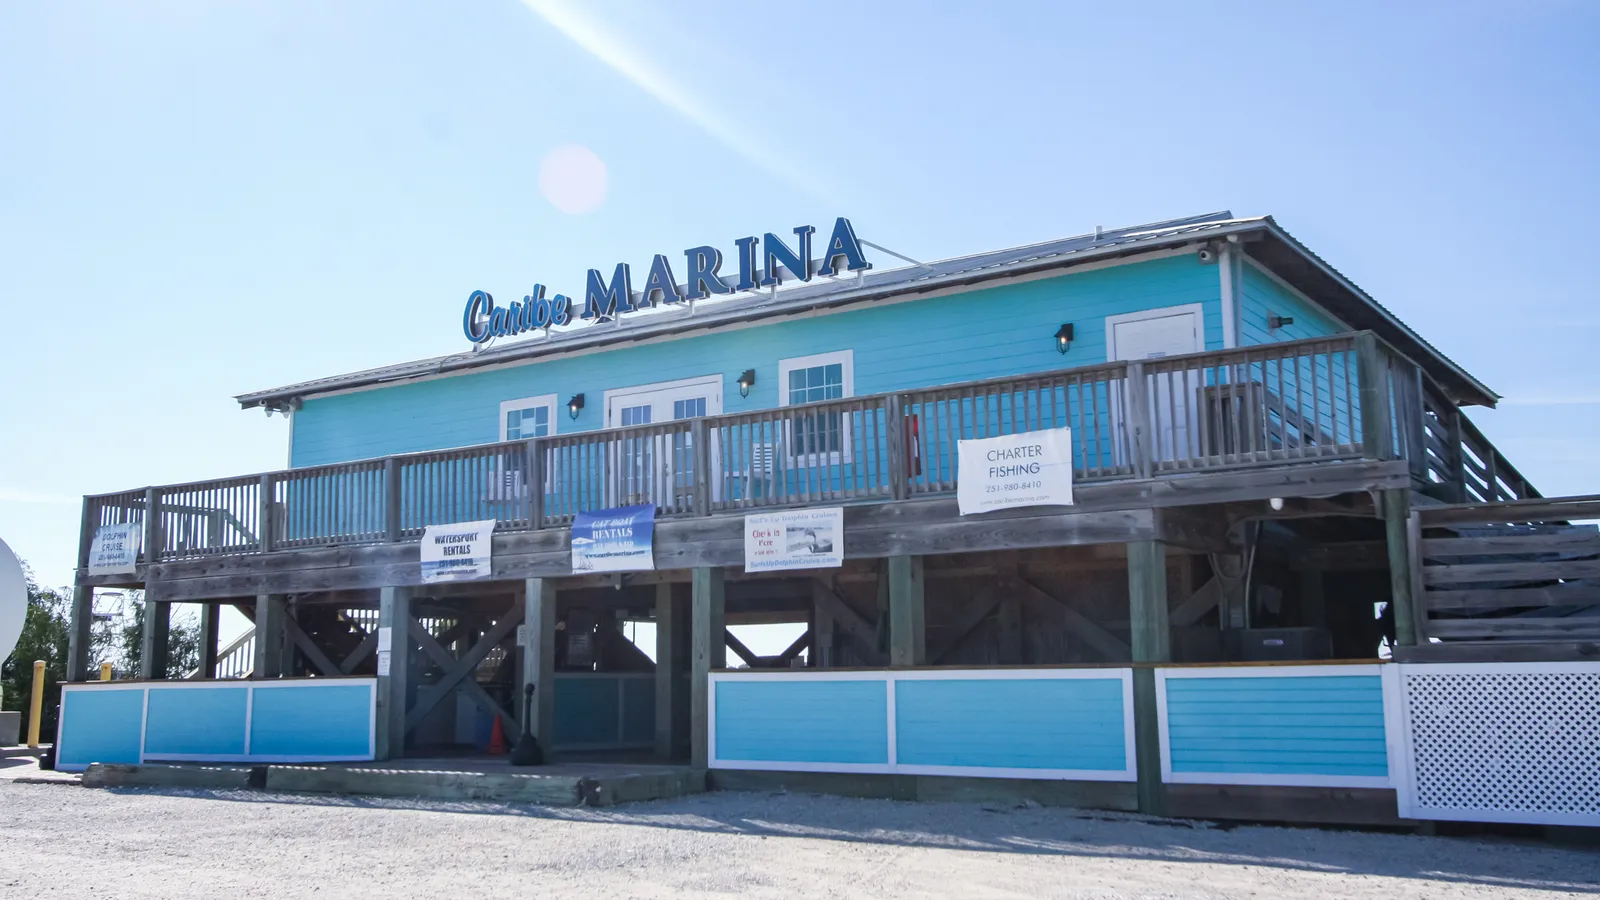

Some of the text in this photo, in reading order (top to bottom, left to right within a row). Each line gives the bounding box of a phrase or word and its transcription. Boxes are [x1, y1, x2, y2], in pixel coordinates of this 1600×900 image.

[463, 217, 872, 343] Caribe MARINA
[986, 445, 1042, 462] CHARTER
[989, 462, 1041, 478] FISHING
[986, 480, 1042, 493] 251-980-8410
[782, 512, 809, 522] Dolphin
[811, 511, 838, 519] Cruises
[592, 520, 611, 529] CAT
[102, 532, 127, 541] DOLPHIN
[434, 532, 479, 545] WATERSPORT
[592, 527, 633, 540] RENTALS
[752, 528, 771, 538] Check
[102, 542, 123, 552] CRUISE
[443, 544, 471, 556] RENTALS
